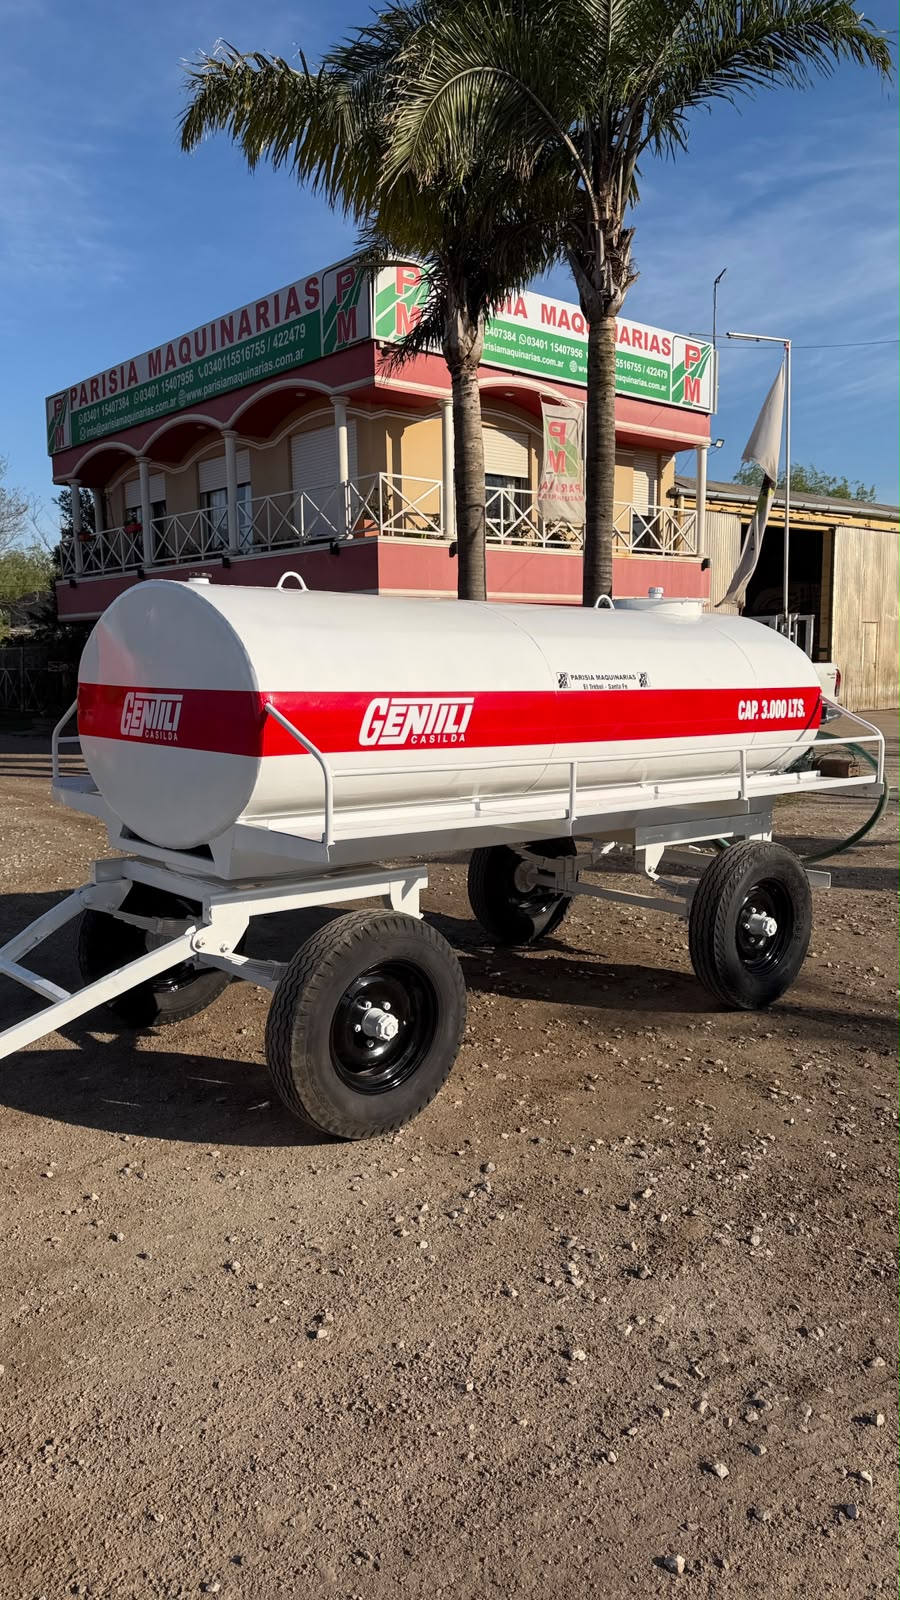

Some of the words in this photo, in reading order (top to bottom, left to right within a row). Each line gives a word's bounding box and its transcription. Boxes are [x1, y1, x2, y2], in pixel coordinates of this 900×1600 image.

[336, 267, 355, 304] P
[395, 265, 421, 294] P
[336, 307, 357, 344] M
[70, 361, 138, 410] PARISIA
[148, 276, 319, 378] MAQUINARIAS
[482, 341, 564, 369] risiamaquinarias.com.ar
[485, 325, 516, 342] 5407384
[526, 336, 548, 350] 03401
[550, 343, 583, 359] 15407956
[646, 366, 668, 379] 422479
[685, 344, 701, 369] P
[83, 408, 100, 423] 03401
[102, 395, 130, 416] 15407384
[140, 384, 159, 402] 03401
[161, 369, 194, 393] 15407956
[203, 340, 265, 377] 0340115516755
[273, 323, 306, 348] 422479
[684, 375, 700, 403] M
[86, 397, 177, 436] info@parisiamaquinarias.com.ar
[186, 348, 304, 400] www.parisiamaquinarias.com.ar
[55, 425, 64, 447] M
[121, 692, 183, 737] GENTILI
[359, 697, 475, 746] GENTILI
[738, 700, 759, 720] CAP.
[761, 699, 787, 719] 3.000
[788, 698, 806, 718] LTS.
[145, 729, 178, 741] CASILDA
[411, 734, 466, 744] CASILDA
